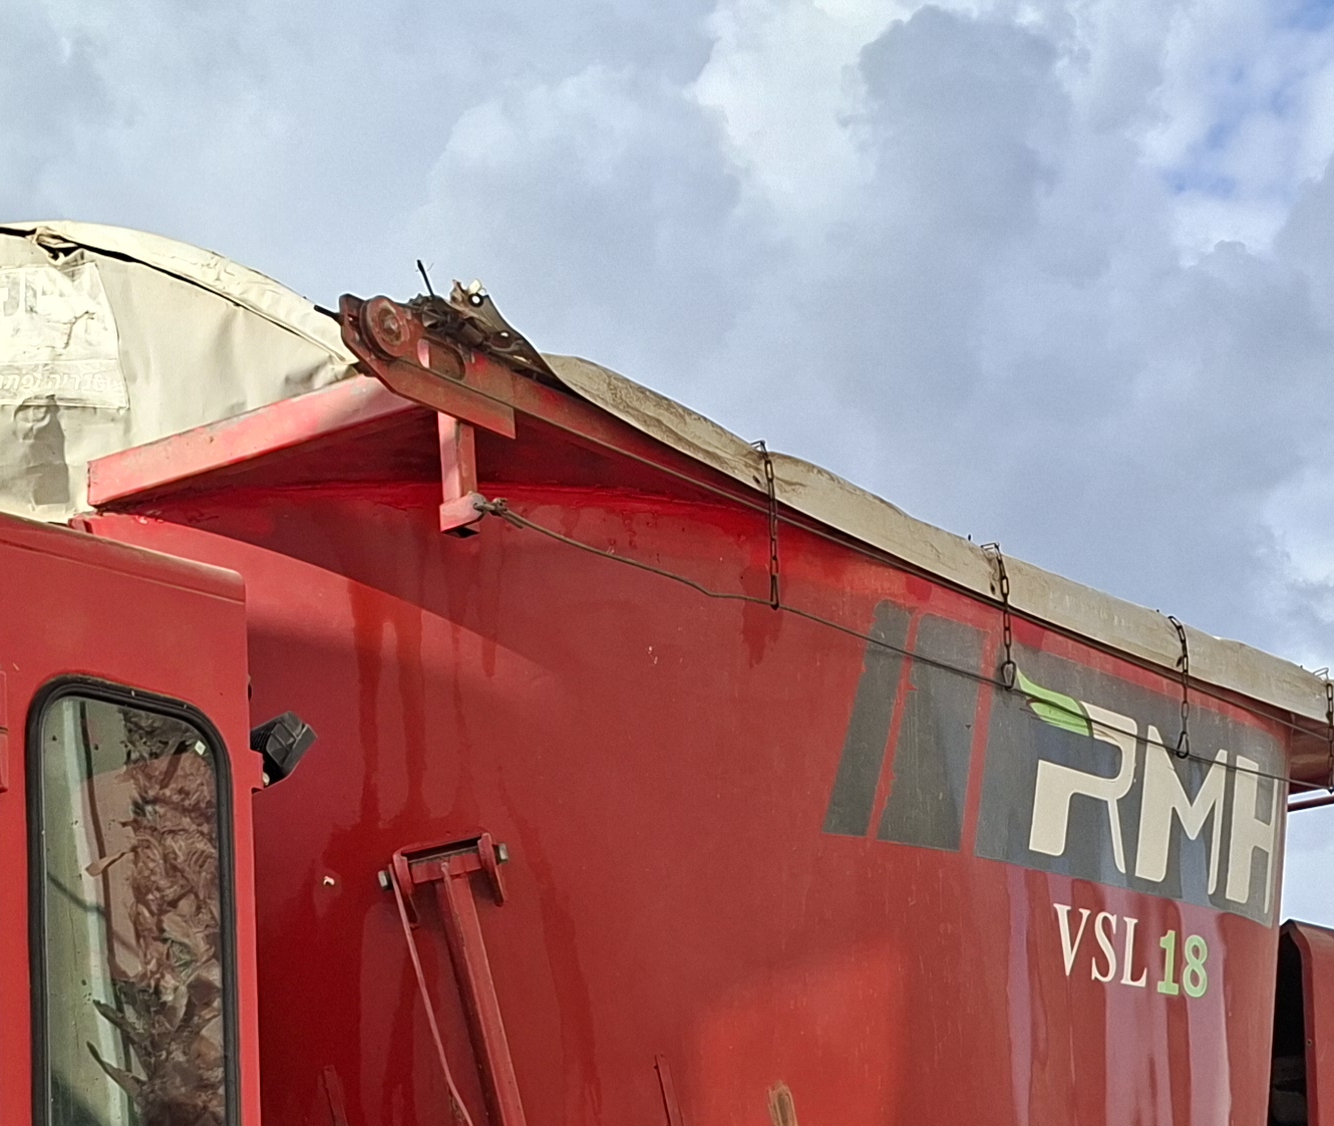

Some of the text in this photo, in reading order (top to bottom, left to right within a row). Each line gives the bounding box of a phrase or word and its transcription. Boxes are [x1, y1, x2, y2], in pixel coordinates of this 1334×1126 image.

[1017, 670, 1281, 915] RMH
[1053, 903, 1209, 998] VSL 18
